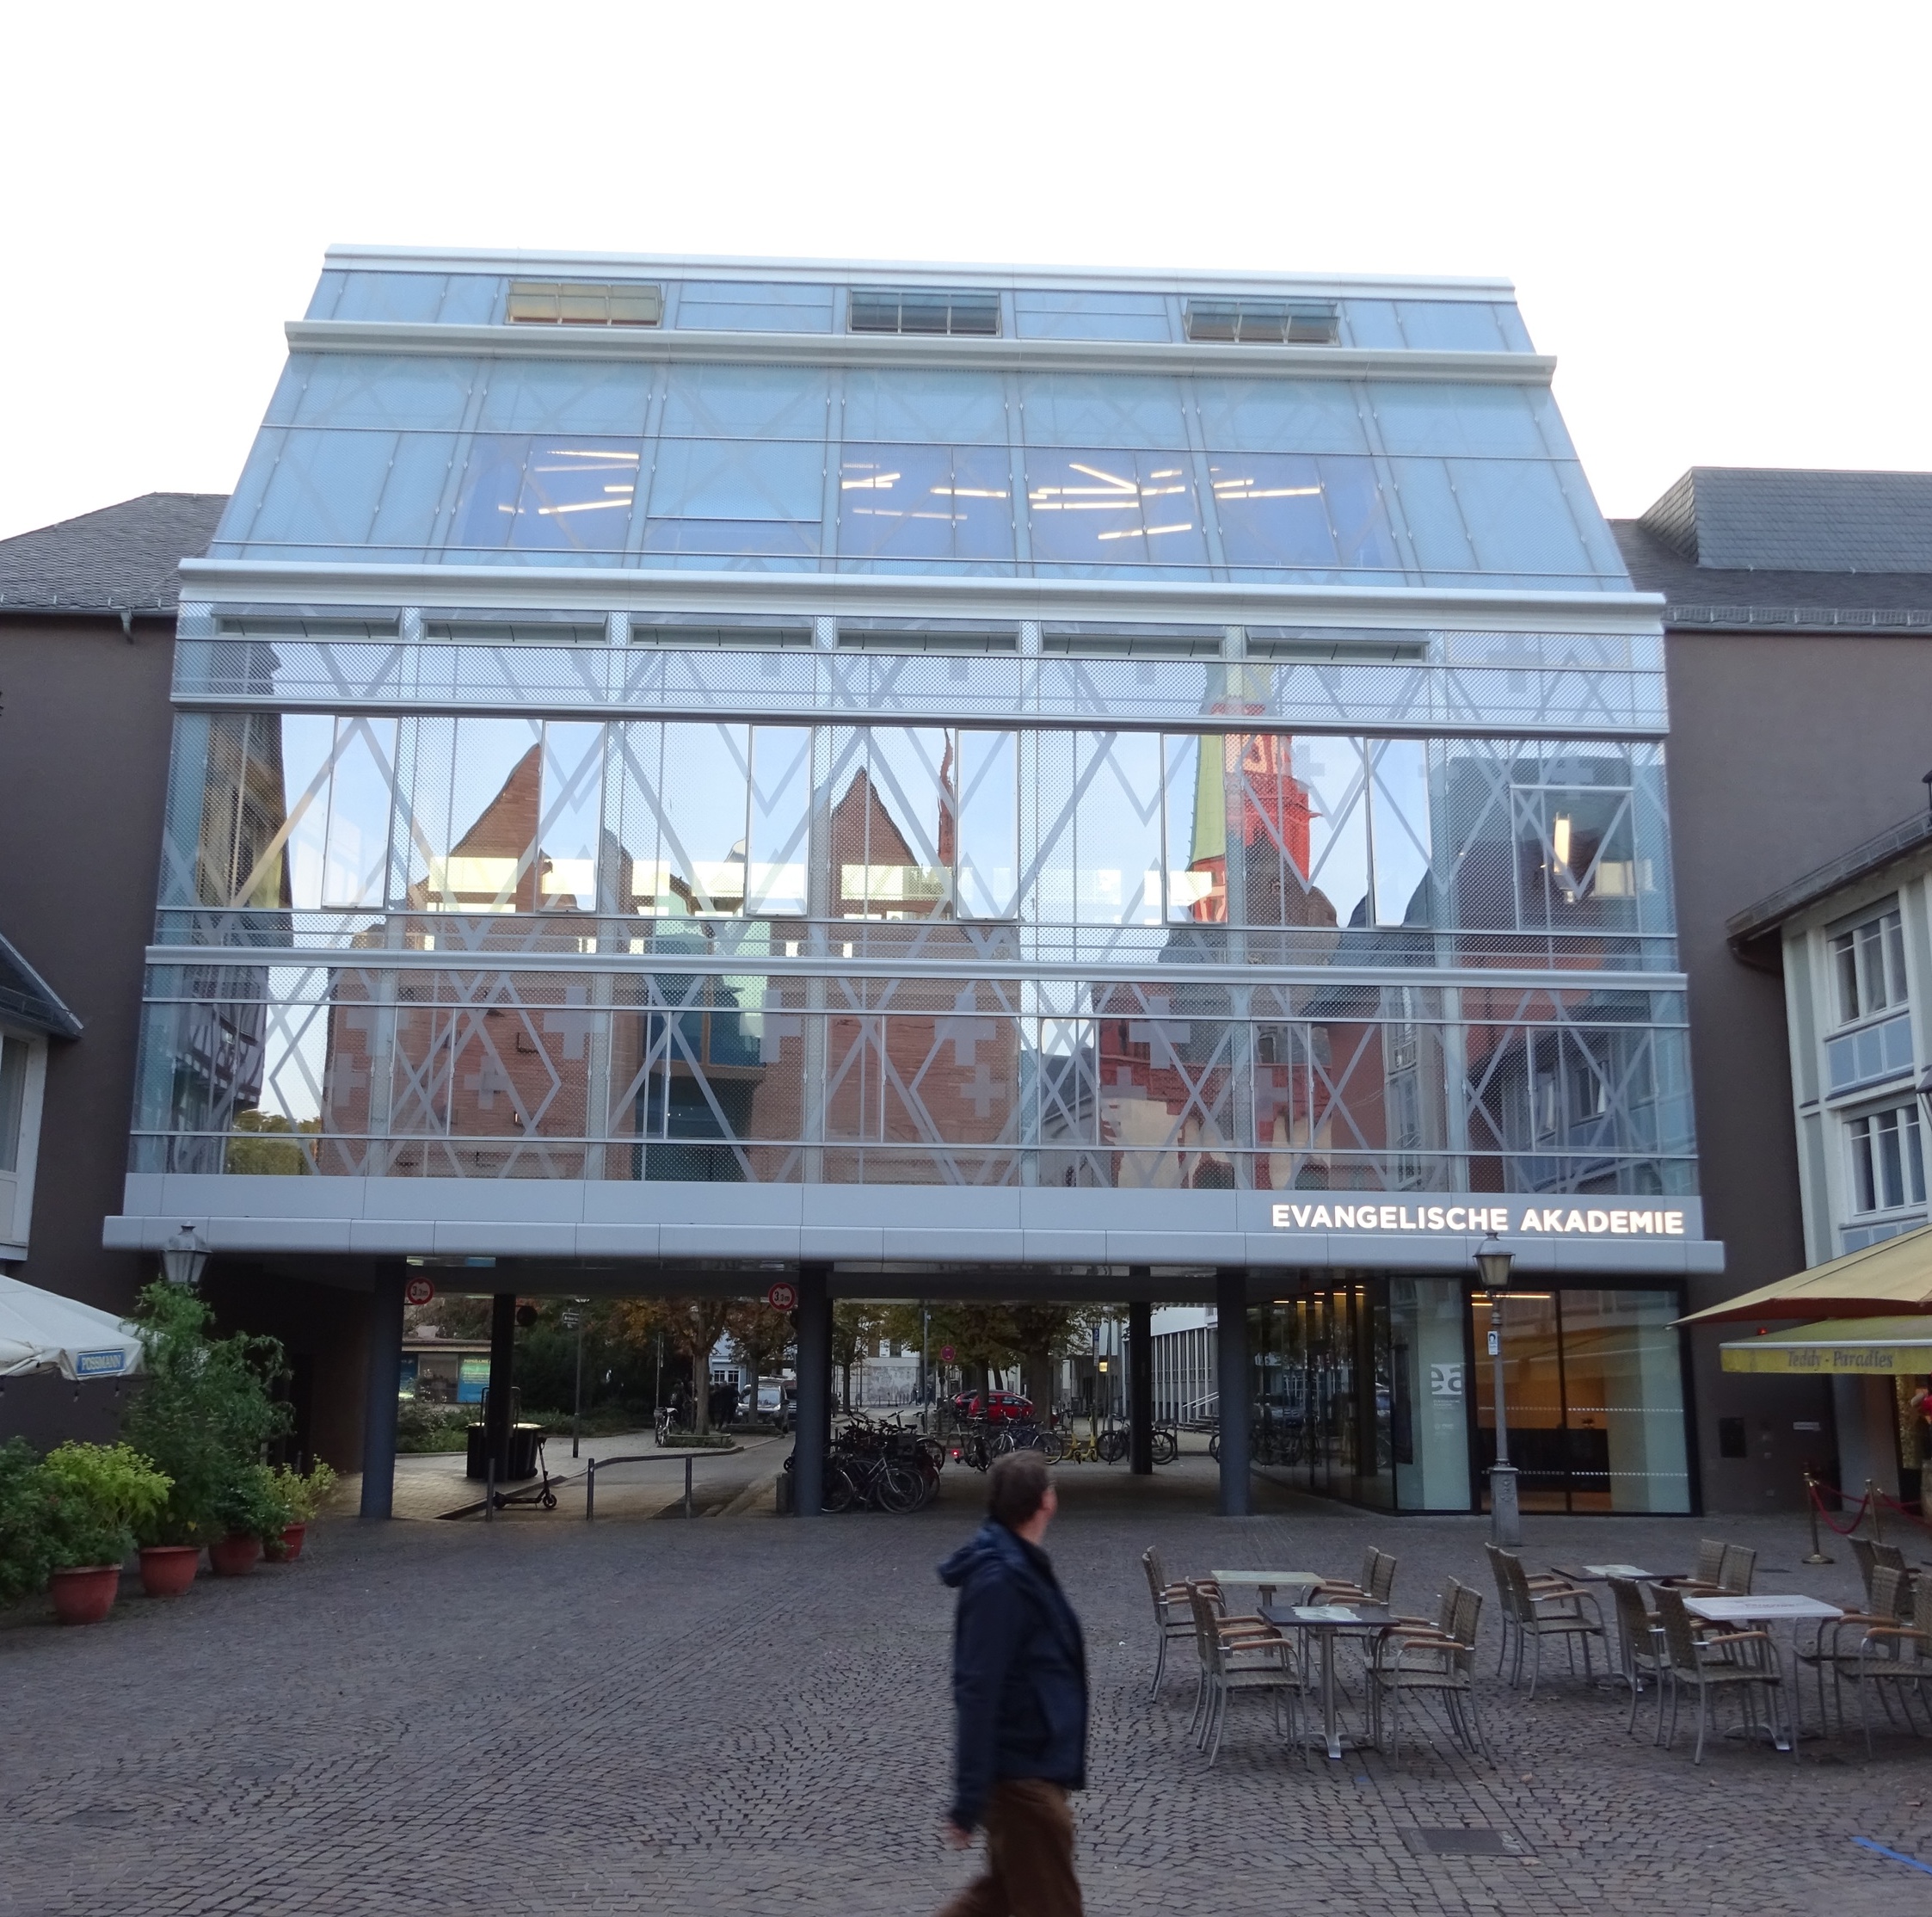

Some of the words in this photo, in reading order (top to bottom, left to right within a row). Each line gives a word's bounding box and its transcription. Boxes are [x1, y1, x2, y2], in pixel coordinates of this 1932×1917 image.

[1272, 1204, 1508, 1231] EVANGELISCHE
[1520, 1208, 1683, 1235] AKADEMIE
[81, 1354, 121, 1371] POSSMANN
[1833, 1349, 1893, 1368] Paradies
